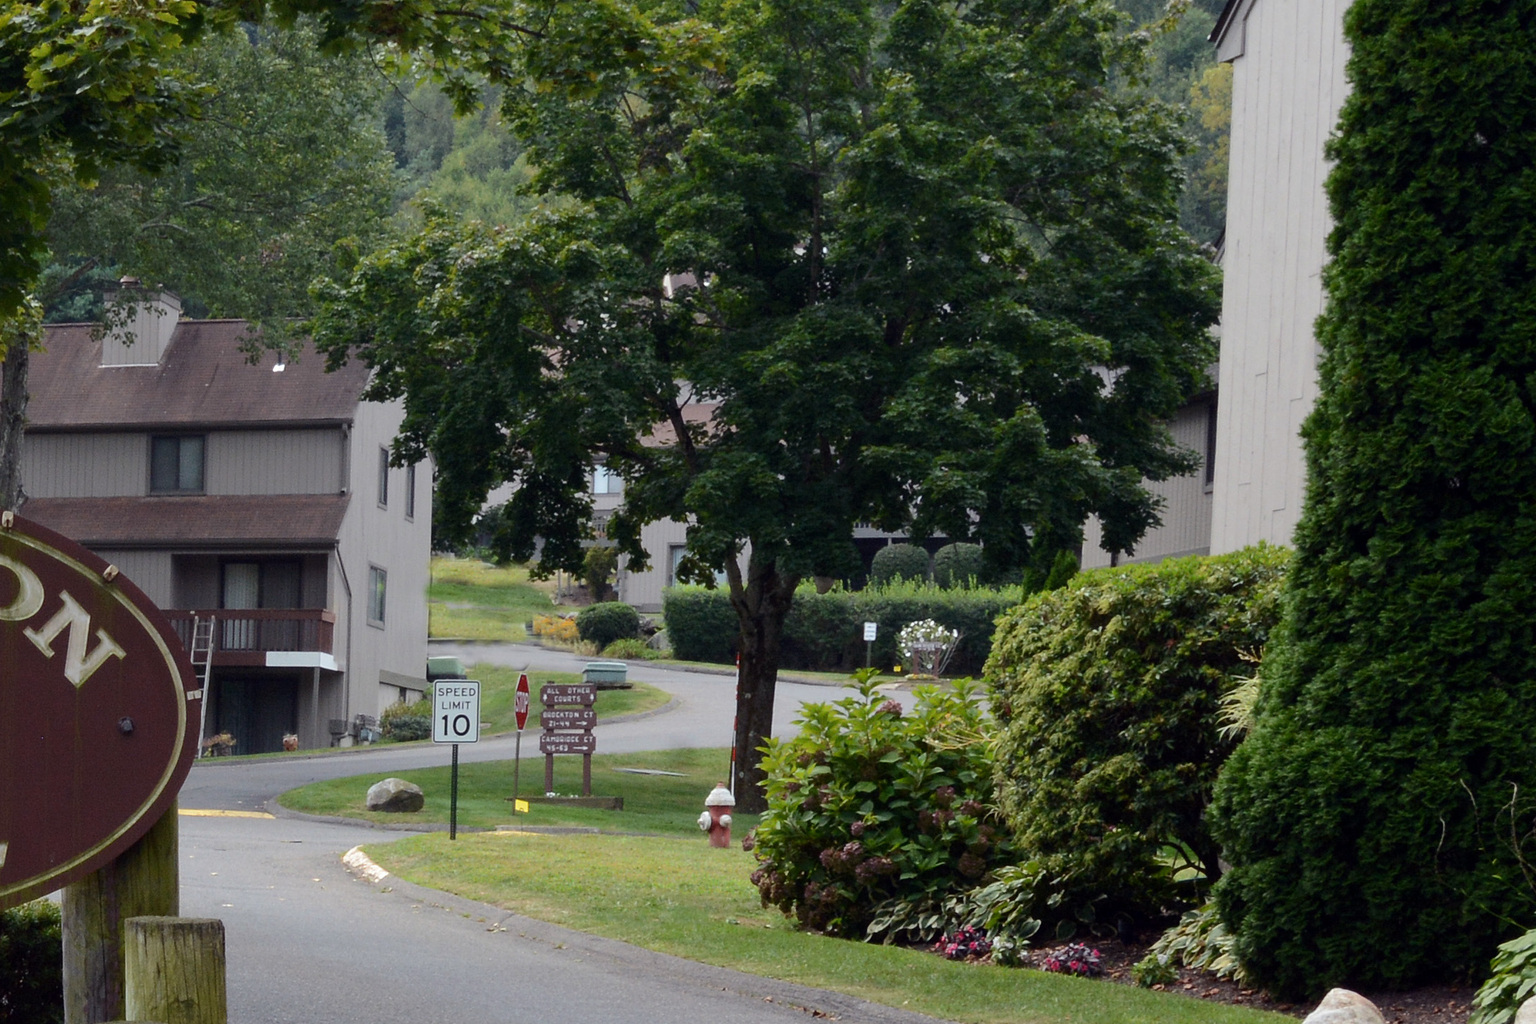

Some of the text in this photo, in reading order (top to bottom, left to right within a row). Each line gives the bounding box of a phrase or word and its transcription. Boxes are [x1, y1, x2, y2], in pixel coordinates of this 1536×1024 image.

[437, 687, 476, 697] SPEED
[441, 701, 472, 711] LIMIT
[441, 714, 471, 736] 10
[541, 735, 594, 743] CAMBRIDGE CT
